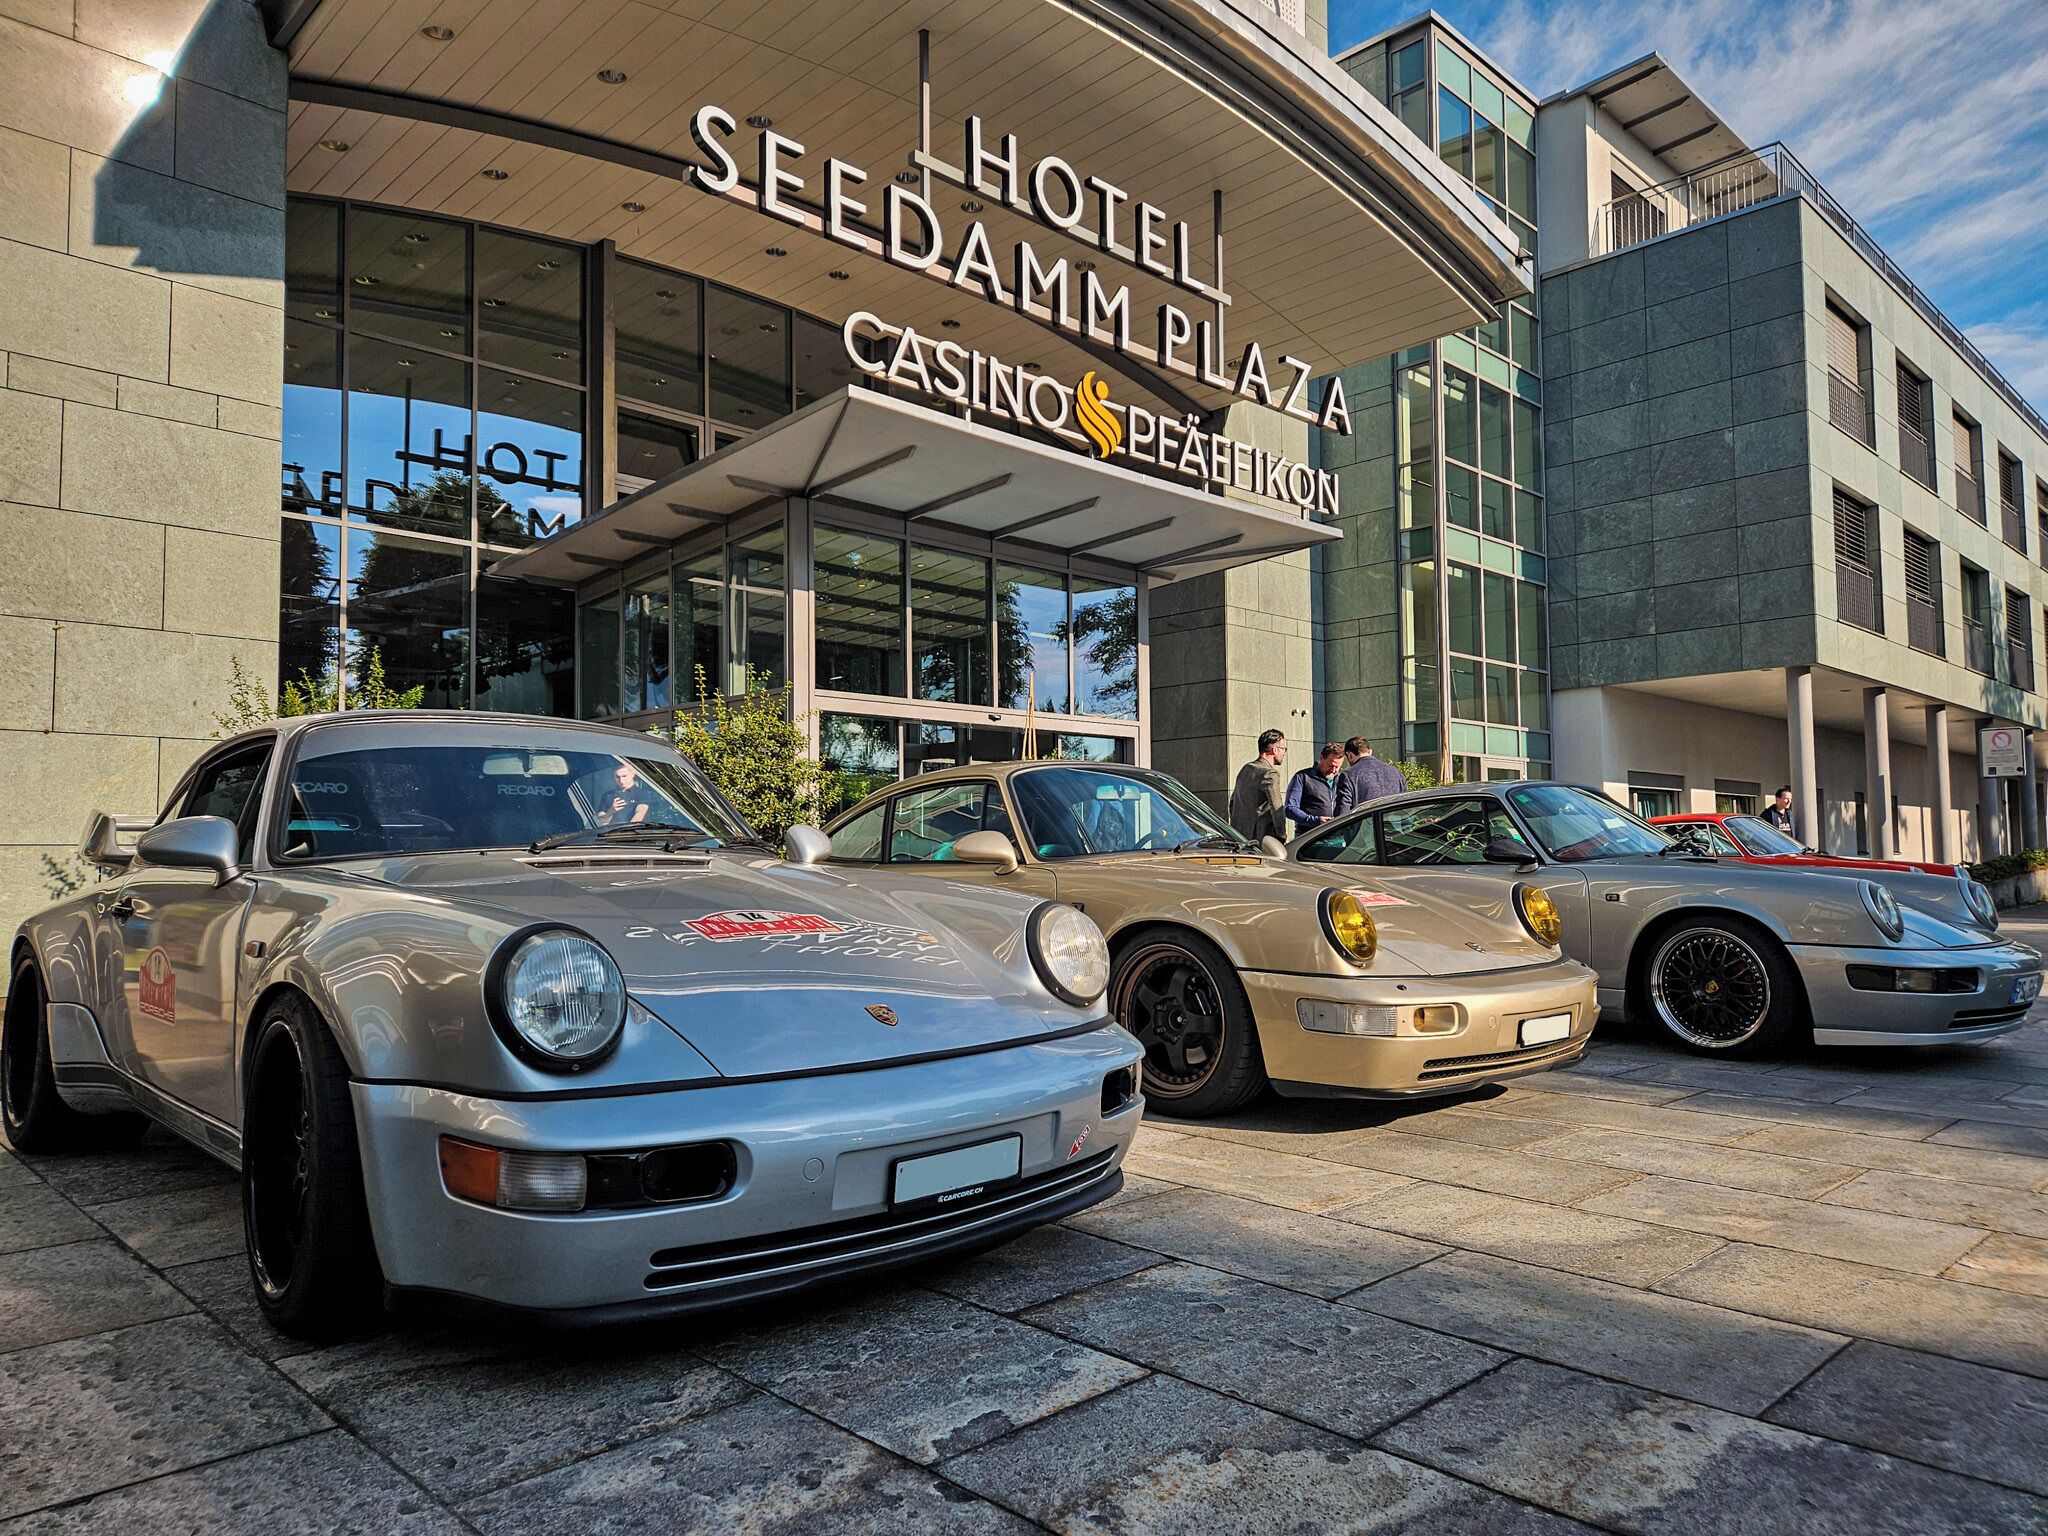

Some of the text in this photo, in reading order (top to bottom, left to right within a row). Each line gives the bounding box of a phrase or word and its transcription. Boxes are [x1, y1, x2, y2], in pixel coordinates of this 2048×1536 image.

[965, 115, 1205, 292] HOTEL
[690, 105, 1353, 436] SEEDAMM PLAZA
[842, 311, 1068, 429] CASINO
[433, 428, 582, 495] HOT
[294, 781, 349, 795] ECARO
[497, 784, 555, 797] RECARO
[736, 912, 768, 922] 14
